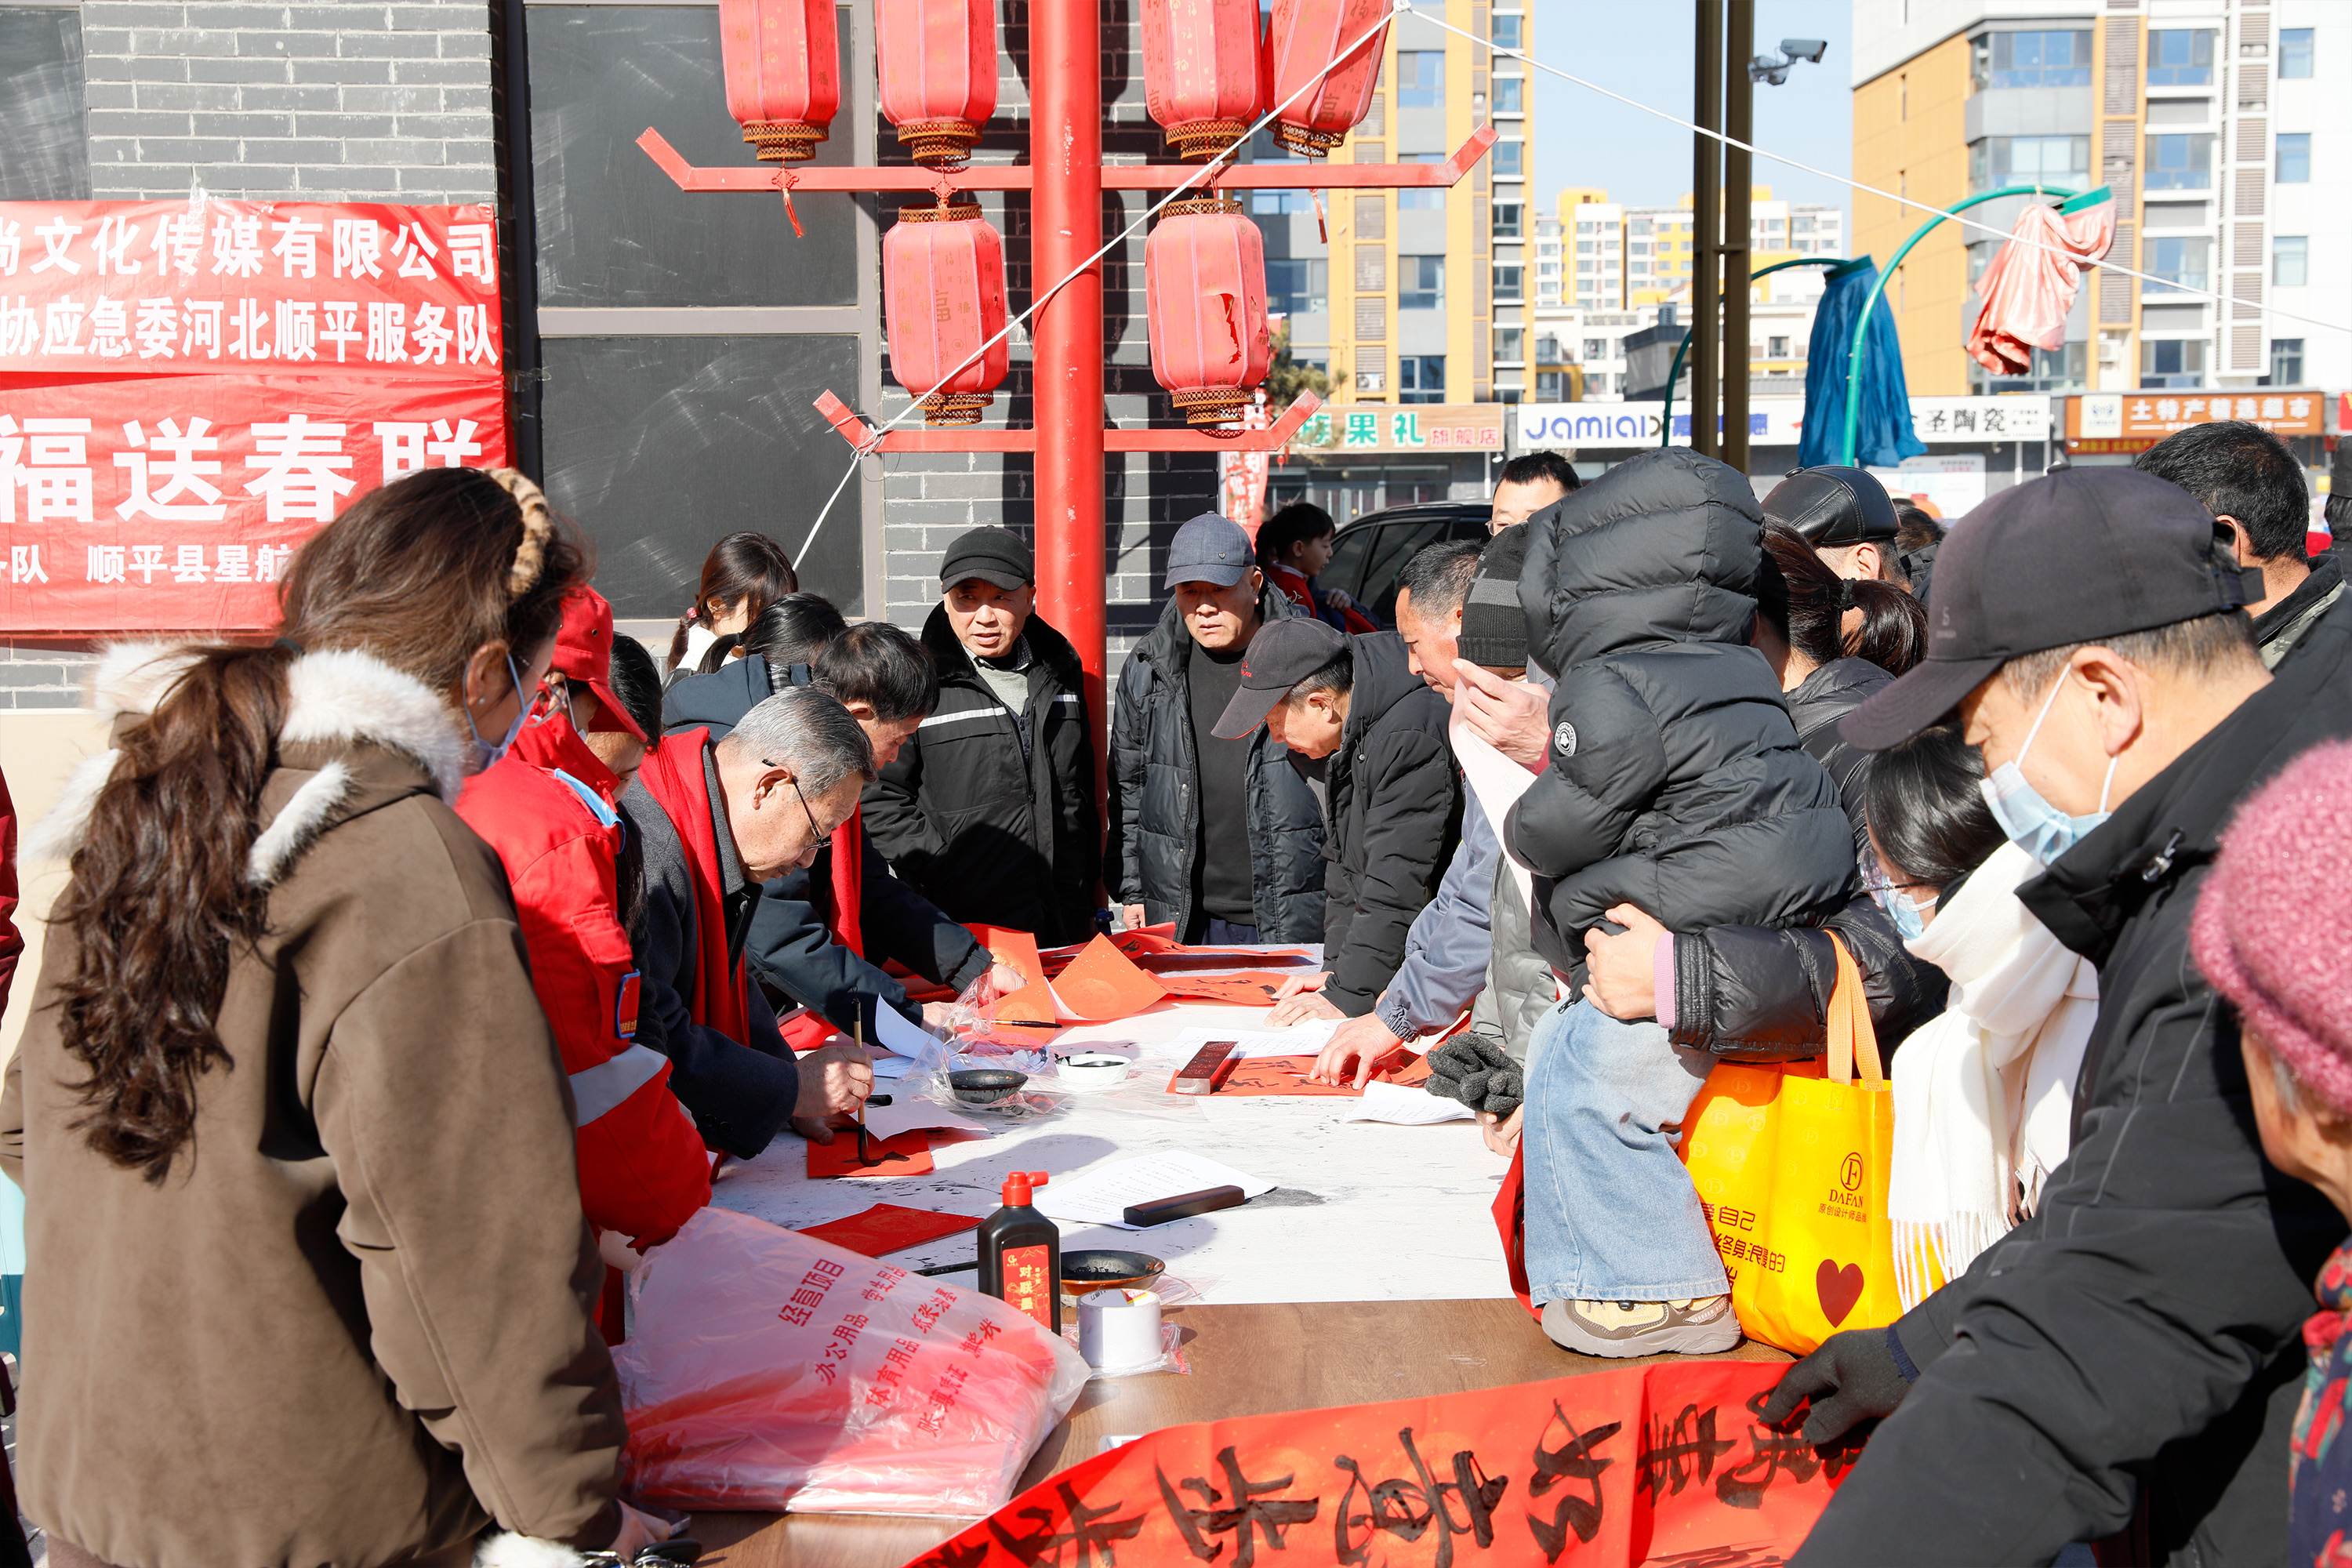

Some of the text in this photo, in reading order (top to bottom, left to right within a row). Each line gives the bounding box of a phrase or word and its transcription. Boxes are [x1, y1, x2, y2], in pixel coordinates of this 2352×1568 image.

[0, 294, 499, 366] 协应急委河北顺平服务队
[1911, 407, 2005, 433] 圣陶瓷
[0, 544, 49, 584] 队
[1818, 1203, 1867, 1223] 原创设计师品牌
[1828, 1188, 1864, 1208] DAFAN
[778, 1258, 845, 1327] 经营项目
[910, 1287, 957, 1334] 纸张油墨
[1018, 1264, 1035, 1319] 对联墨
[814, 1314, 869, 1386] 办公用品
[865, 1338, 920, 1409] 体育用品
